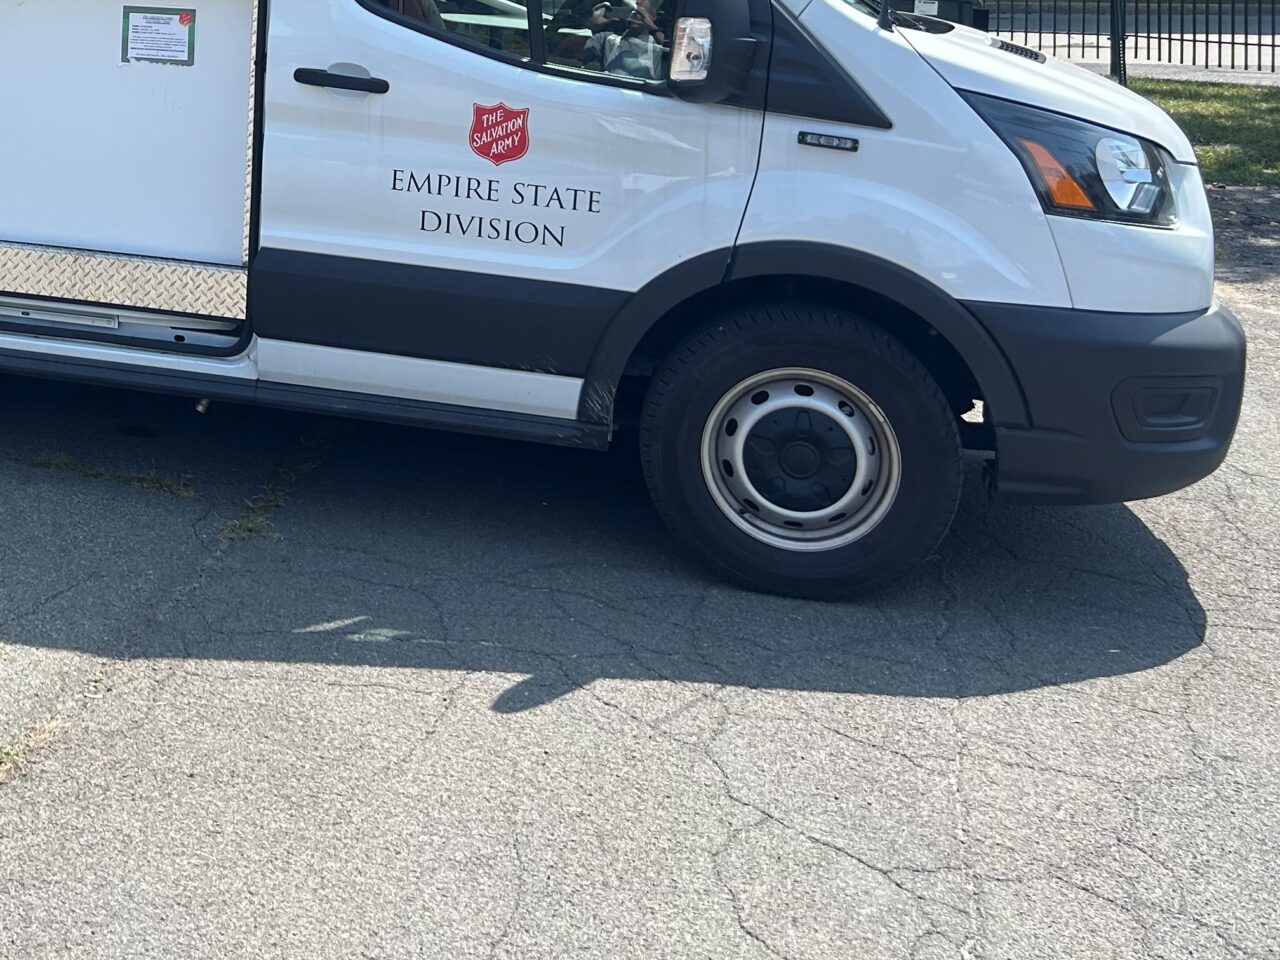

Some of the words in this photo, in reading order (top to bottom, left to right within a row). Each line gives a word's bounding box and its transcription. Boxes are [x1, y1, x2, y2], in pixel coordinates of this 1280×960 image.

[472, 113, 524, 148] SALVATION
[481, 109, 505, 128] THE
[489, 132, 522, 157] ARMY
[391, 168, 500, 203] EMPIRE
[511, 182, 602, 214] STATE
[419, 209, 566, 248] DIVISION
